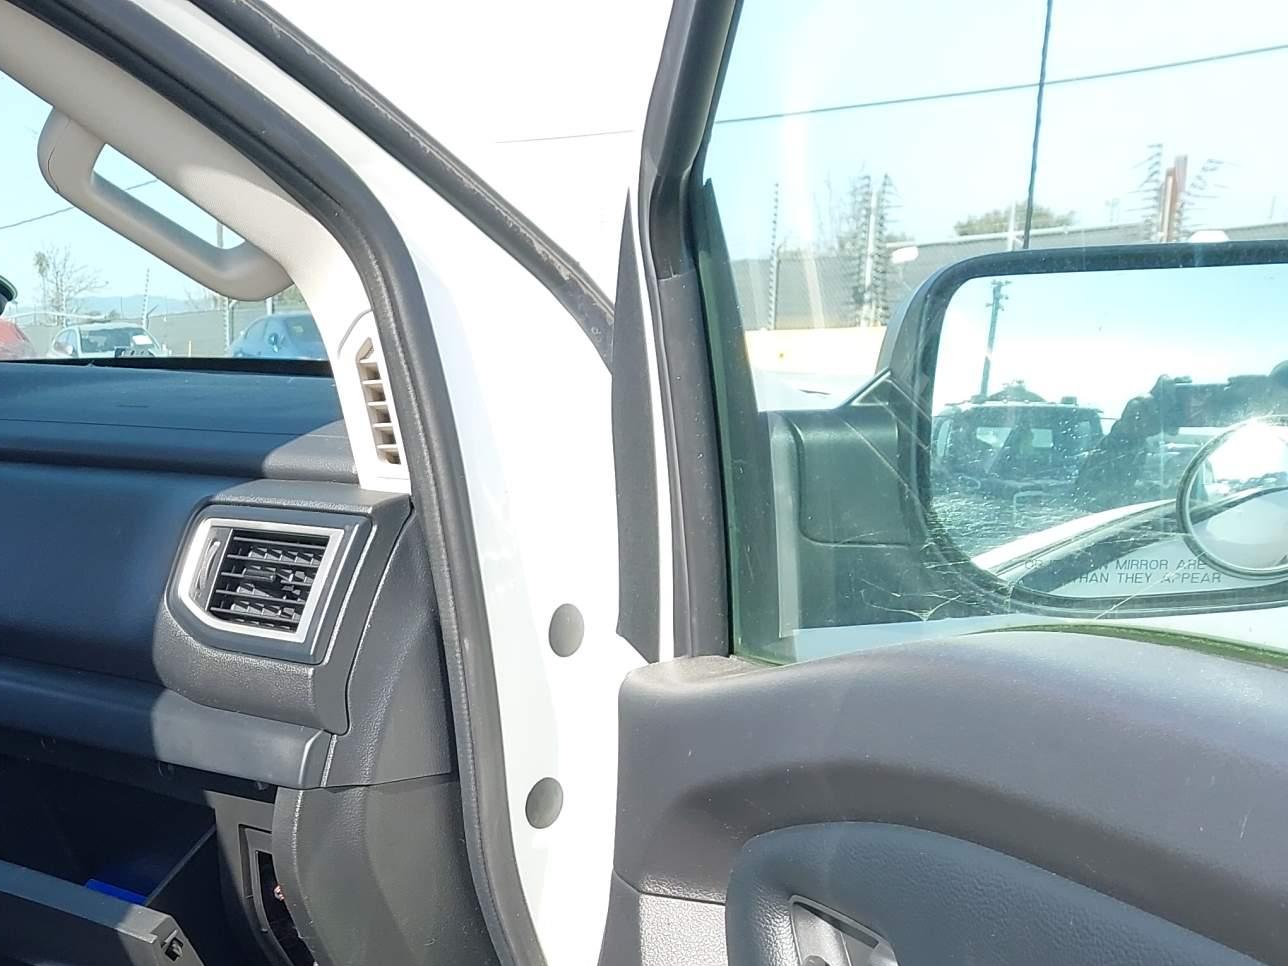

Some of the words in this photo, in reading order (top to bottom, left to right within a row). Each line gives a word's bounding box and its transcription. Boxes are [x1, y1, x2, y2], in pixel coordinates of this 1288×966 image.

[1115, 559, 1169, 570] MIRROR
[1176, 559, 1208, 570] ARE
[1118, 572, 1153, 584] THEY
